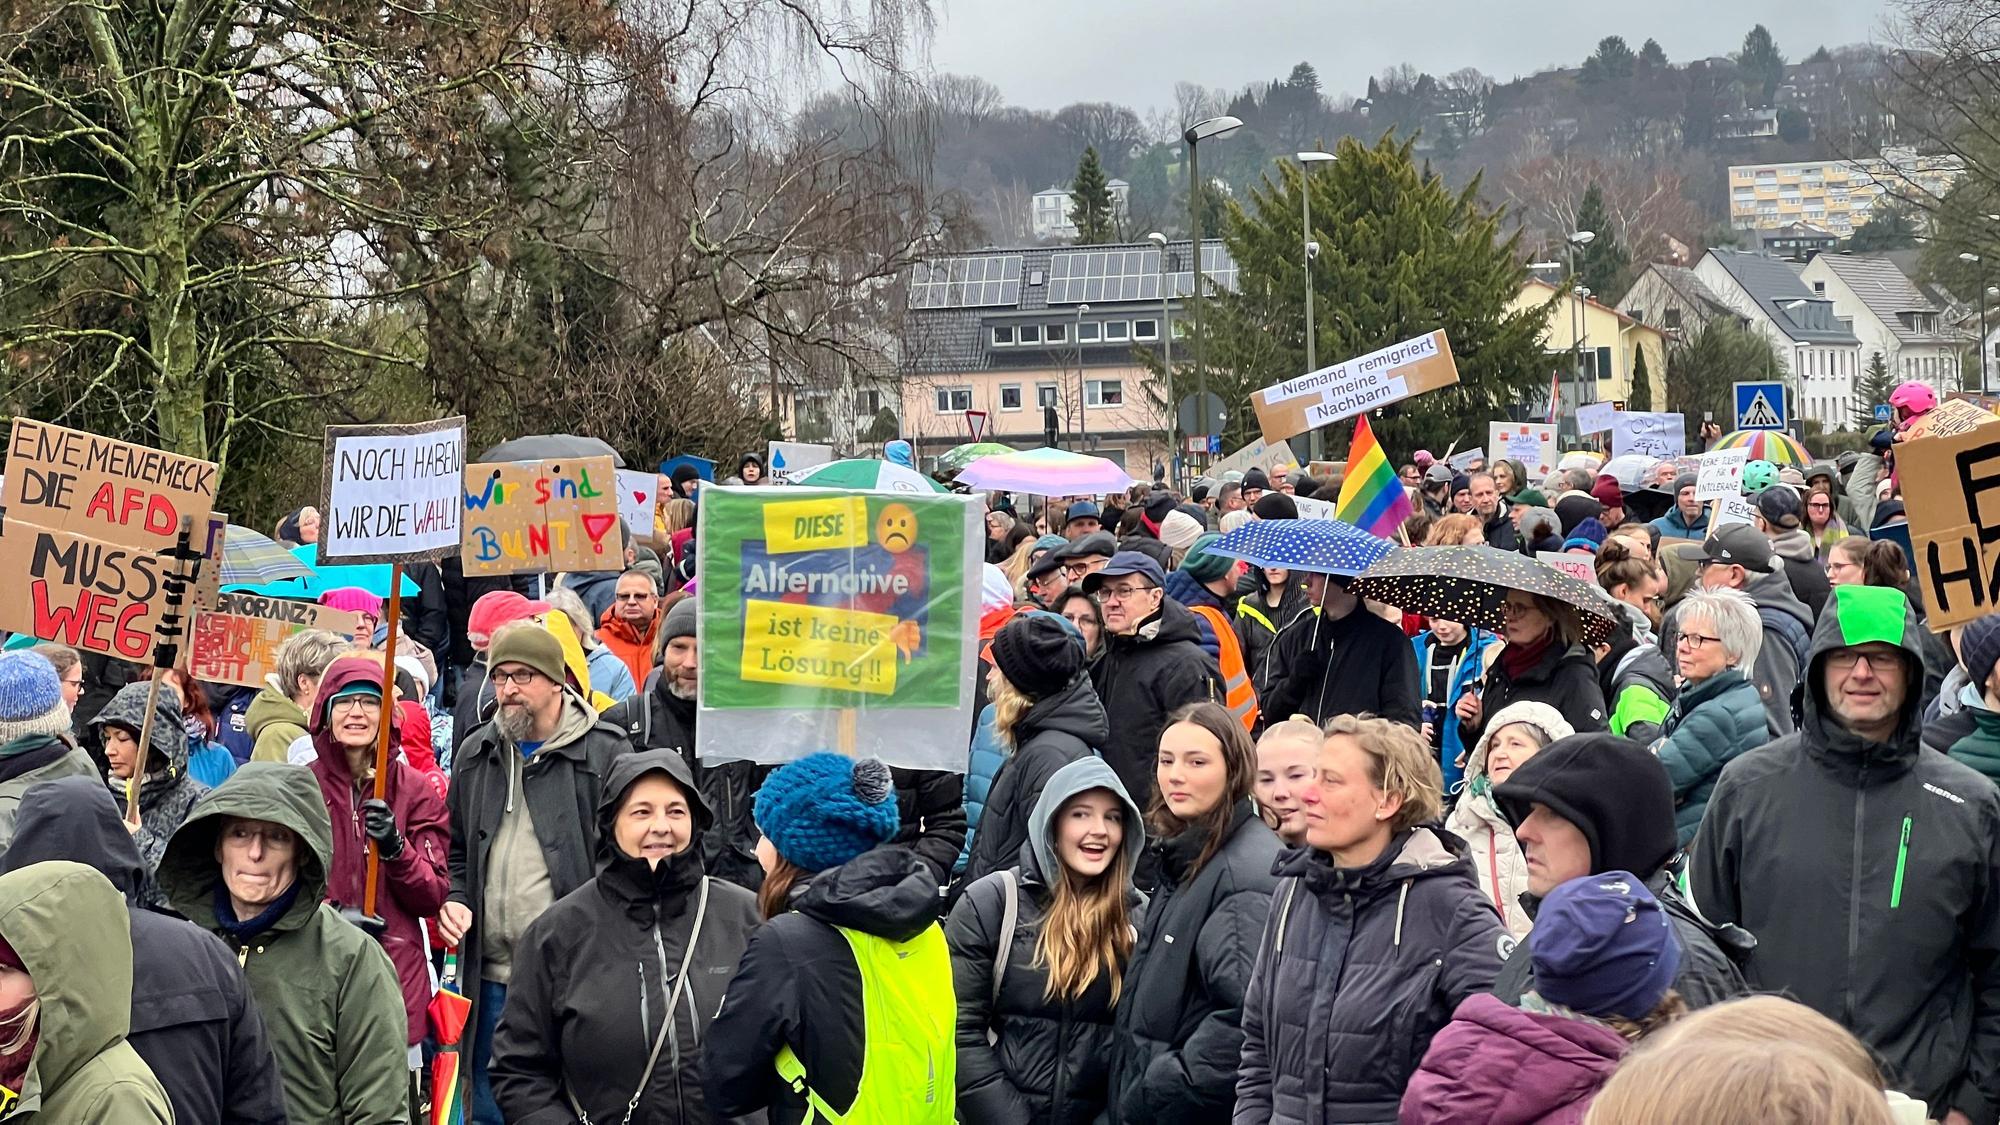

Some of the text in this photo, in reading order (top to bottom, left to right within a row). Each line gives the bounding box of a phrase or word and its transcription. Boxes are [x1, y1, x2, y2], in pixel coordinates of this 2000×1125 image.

[1282, 337, 1434, 396] Niemand remigriert
[1332, 374, 1377, 397] meine
[1317, 385, 1391, 419] Nachbarn
[1926, 408, 1979, 433] FREUND
[339, 440, 460, 482] NOCH HABEN
[20, 467, 178, 537] DIE AFD
[464, 469, 521, 512] Wir
[534, 464, 604, 505] sind
[335, 496, 457, 539] WIR DIE WAHL!
[794, 513, 845, 540] DIESE
[30, 532, 157, 602] MUSS
[744, 561, 909, 595] Alternative
[31, 578, 152, 659] WEG
[216, 593, 318, 625] GNORANZ?
[767, 612, 880, 646] ist keine
